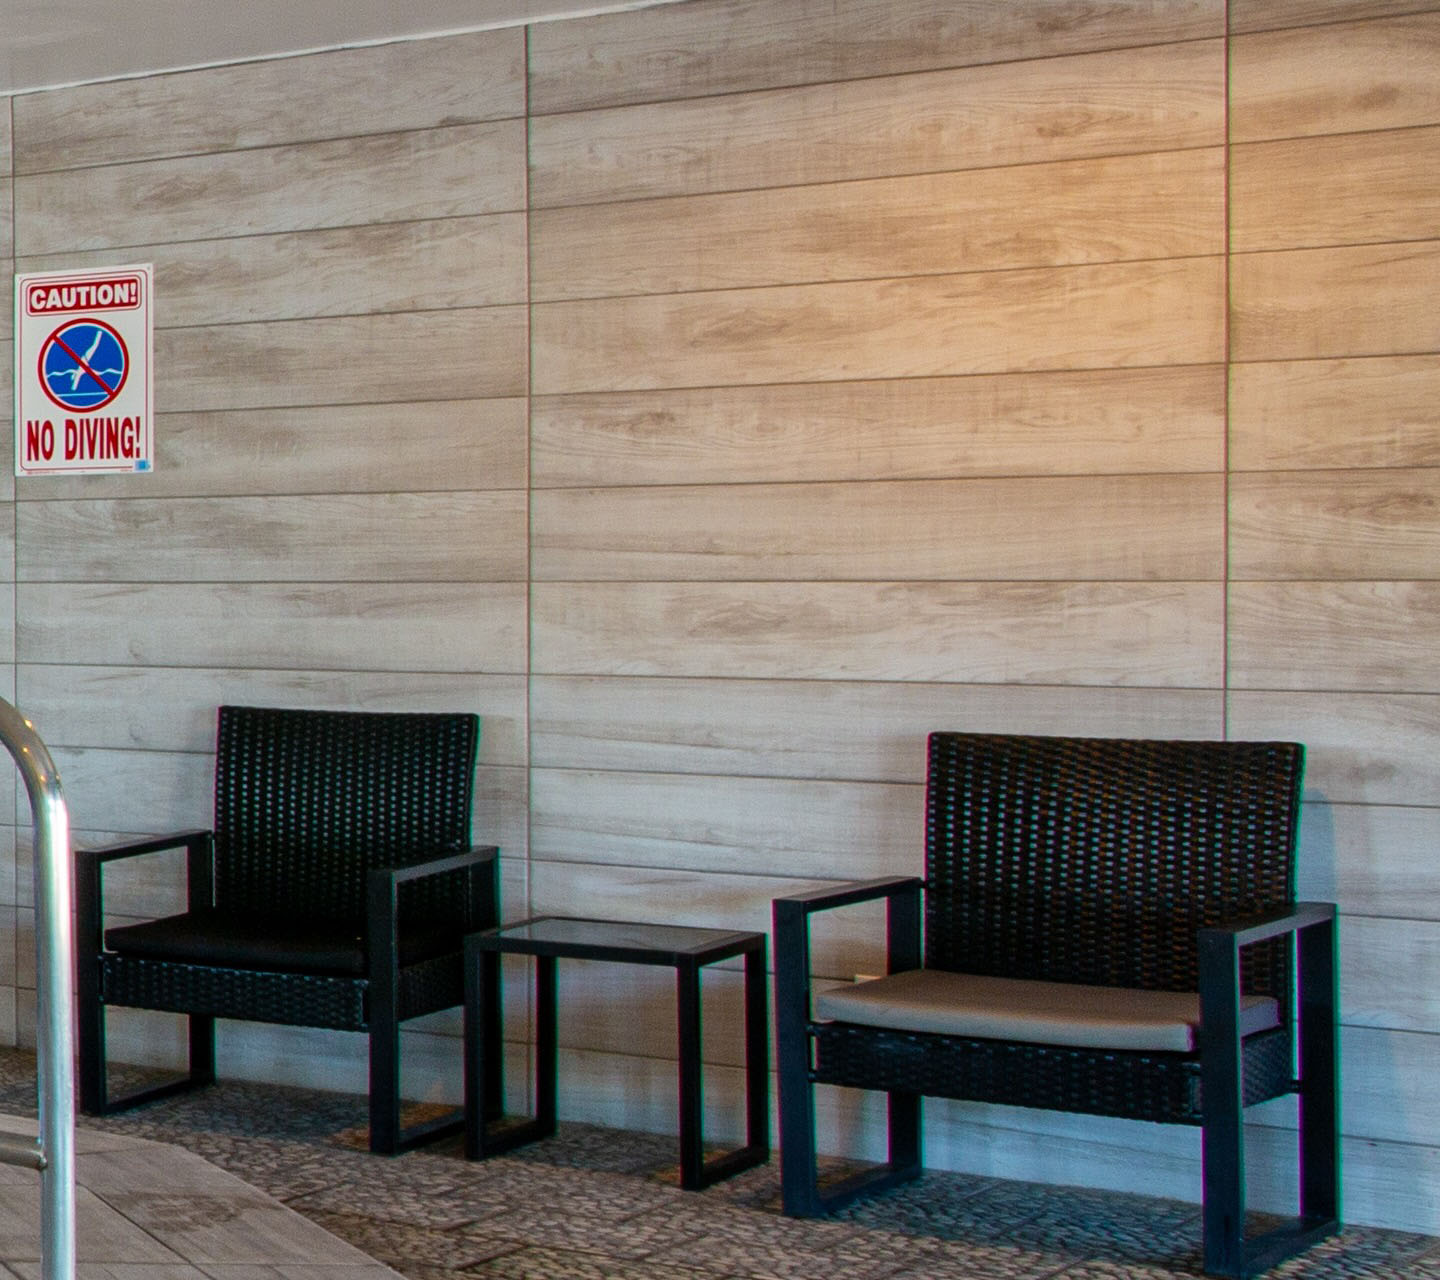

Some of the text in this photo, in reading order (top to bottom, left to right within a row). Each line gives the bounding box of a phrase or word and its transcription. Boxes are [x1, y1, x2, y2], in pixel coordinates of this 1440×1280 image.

[31, 282, 137, 310] CAUTION!
[27, 416, 141, 461] NO DIVING!
